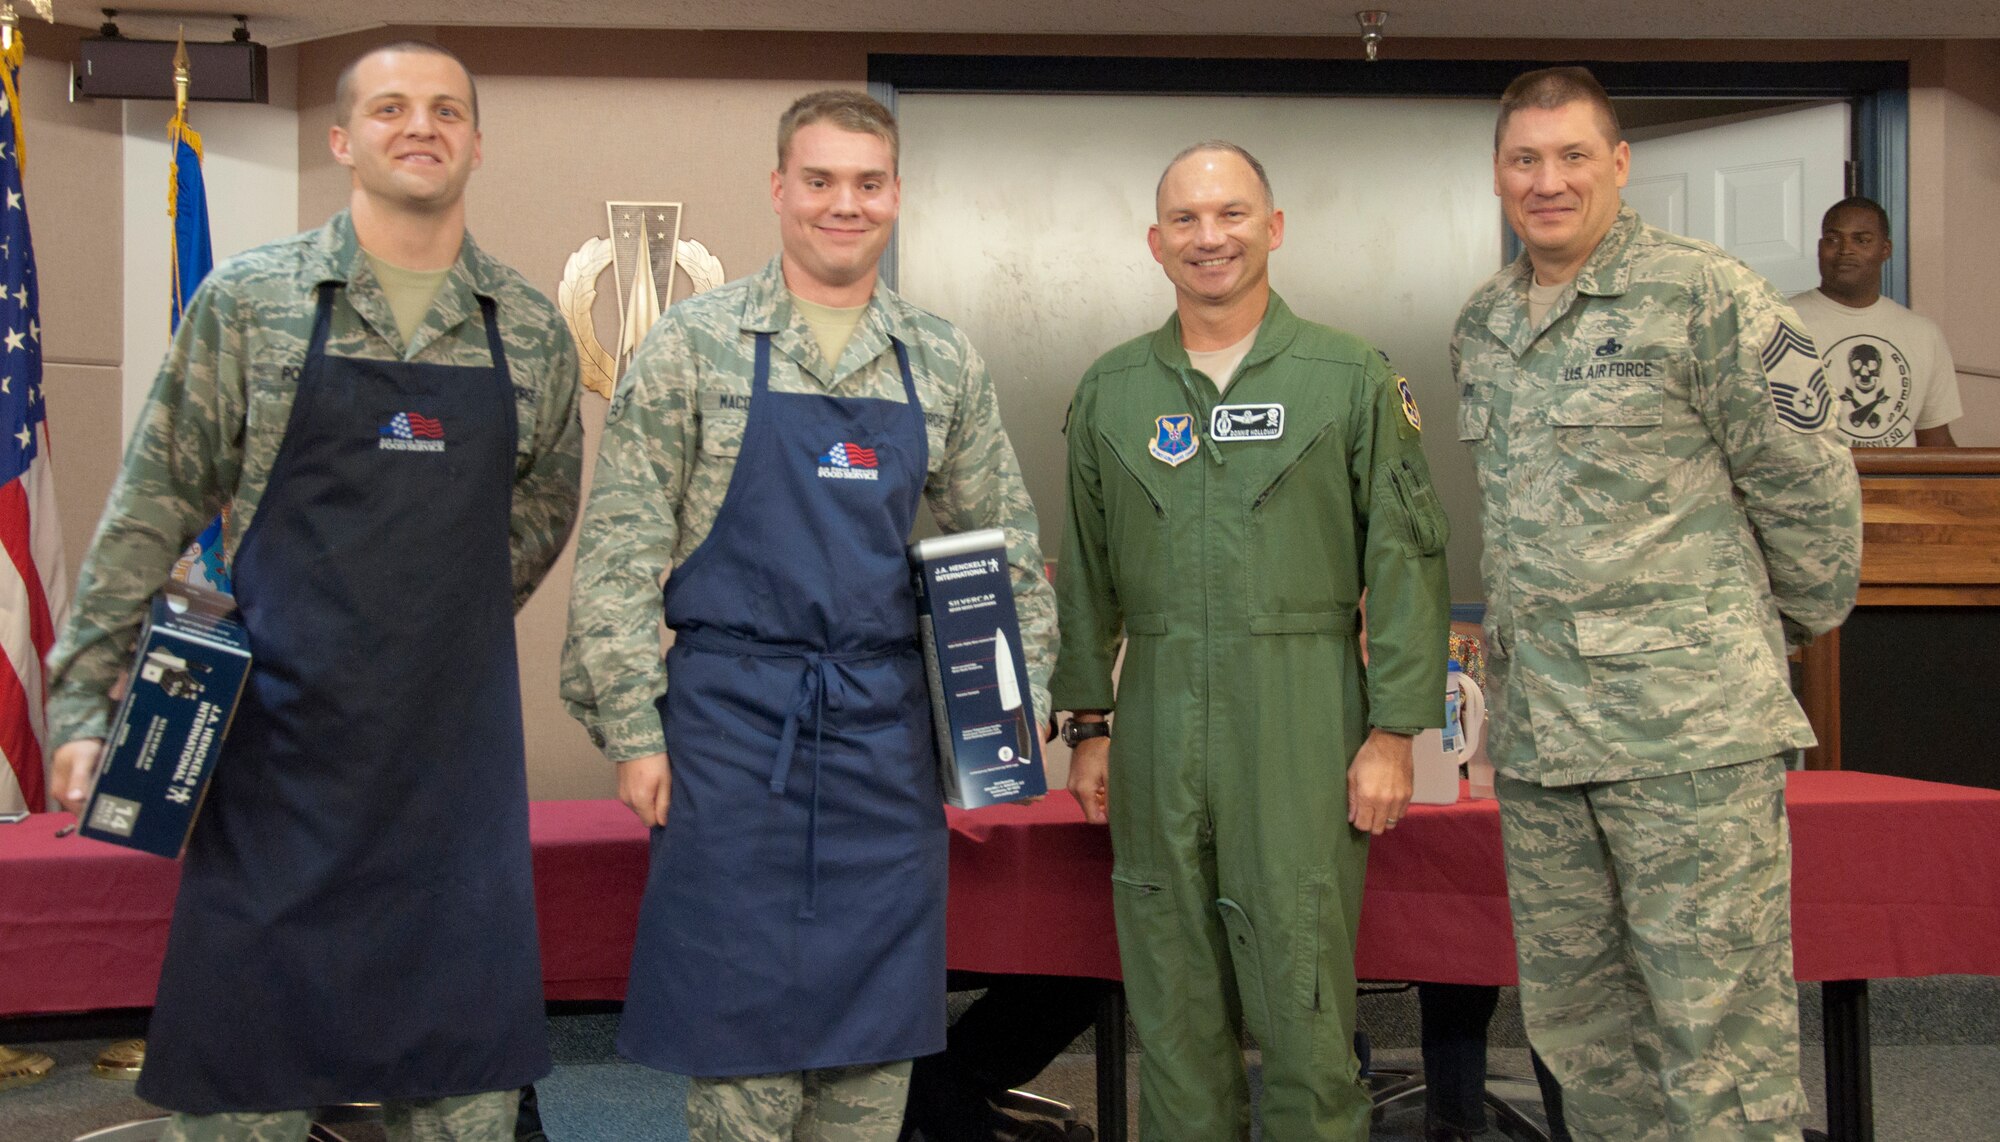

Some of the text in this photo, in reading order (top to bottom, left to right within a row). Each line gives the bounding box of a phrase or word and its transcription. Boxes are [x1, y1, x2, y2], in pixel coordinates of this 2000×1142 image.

[1586, 363, 1606, 379] AIR
[1608, 361, 1652, 377] FORCE
[1887, 353, 1909, 423] ROGERS
[1889, 428, 1904, 443] SQ
[818, 471, 878, 480] FOOD SERVICE
[949, 560, 987, 572] HENCKELS
[935, 568, 988, 582] INTERNATIONAL
[948, 593, 995, 607] SILVERCAP
[172, 701, 211, 782] INTERNATIONAL
[184, 704, 222, 786] J.A. HENCKELS
[110, 806, 134, 830] 14
